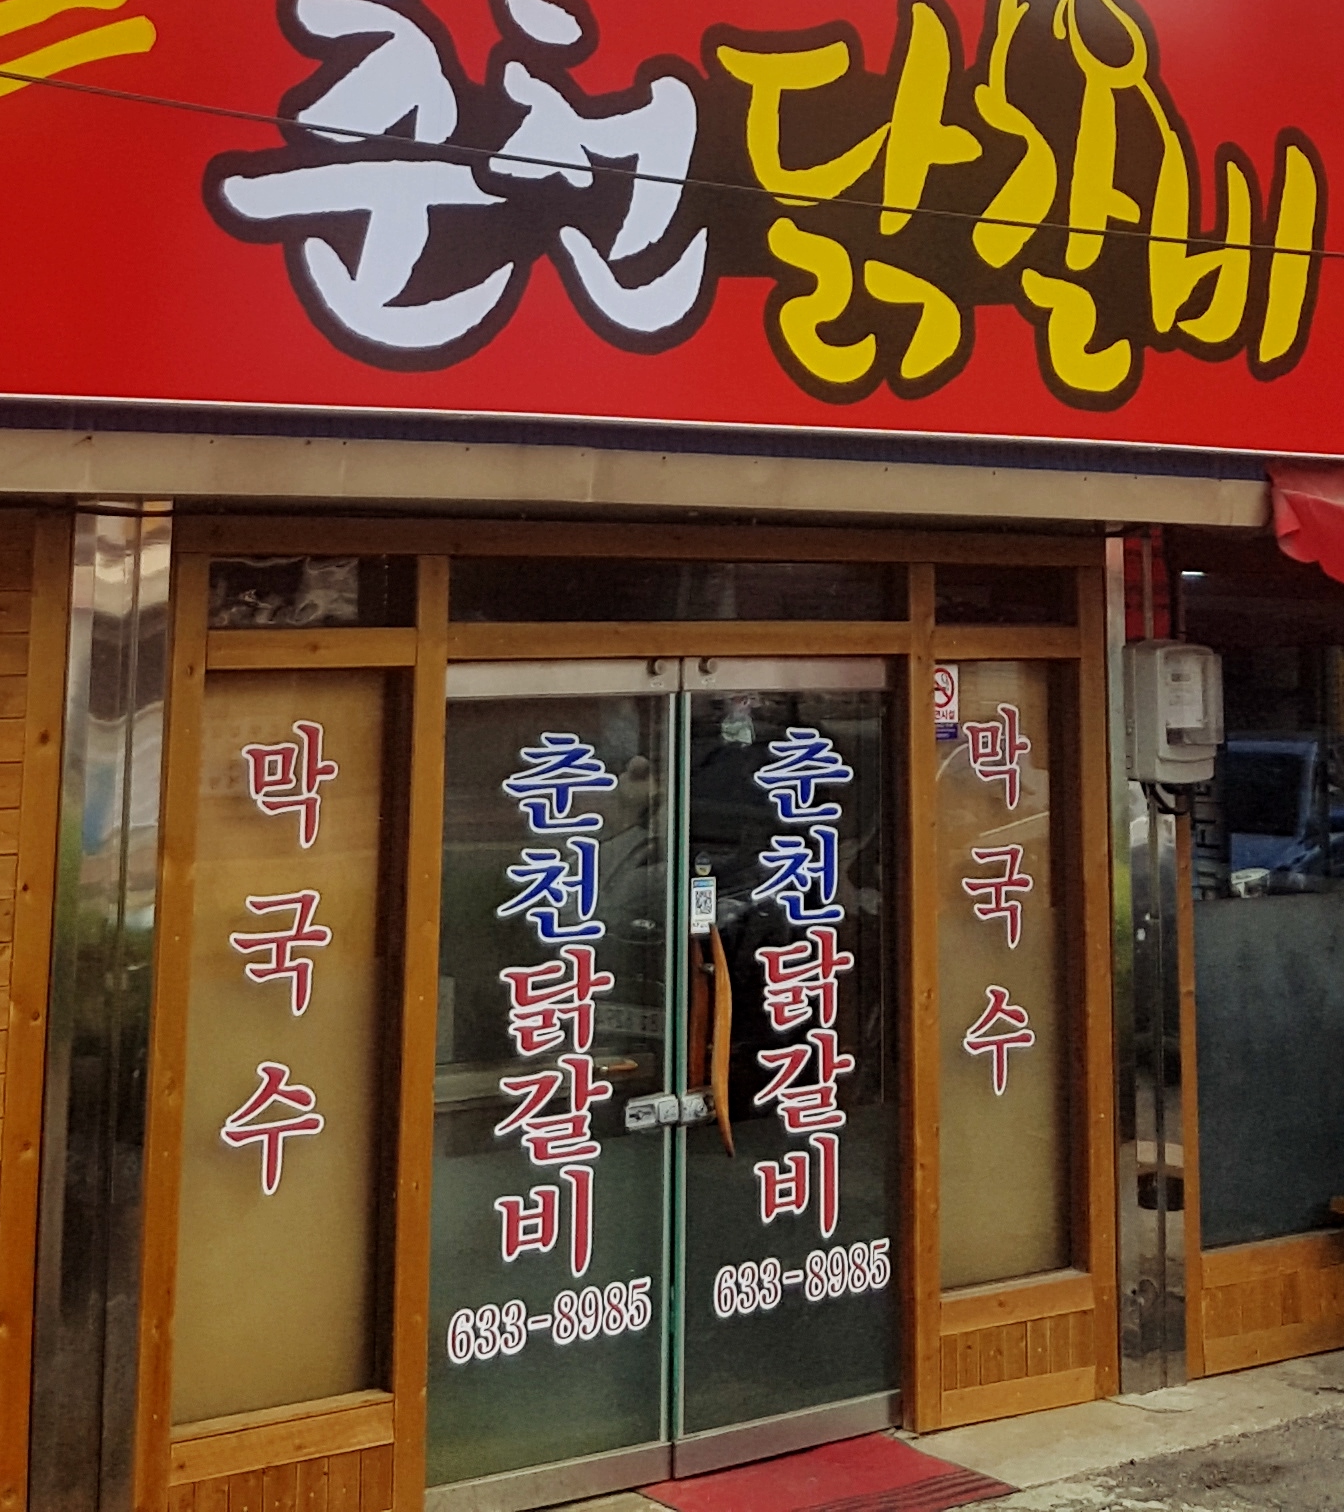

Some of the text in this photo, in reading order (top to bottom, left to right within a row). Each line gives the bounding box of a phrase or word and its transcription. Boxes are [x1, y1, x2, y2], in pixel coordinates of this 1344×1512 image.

[221, 720, 338, 1195] 막국수
[962, 703, 1036, 1096] 막국수
[447, 1276, 652, 1364] 633-8985
[713, 1238, 892, 1317] 633-8985
